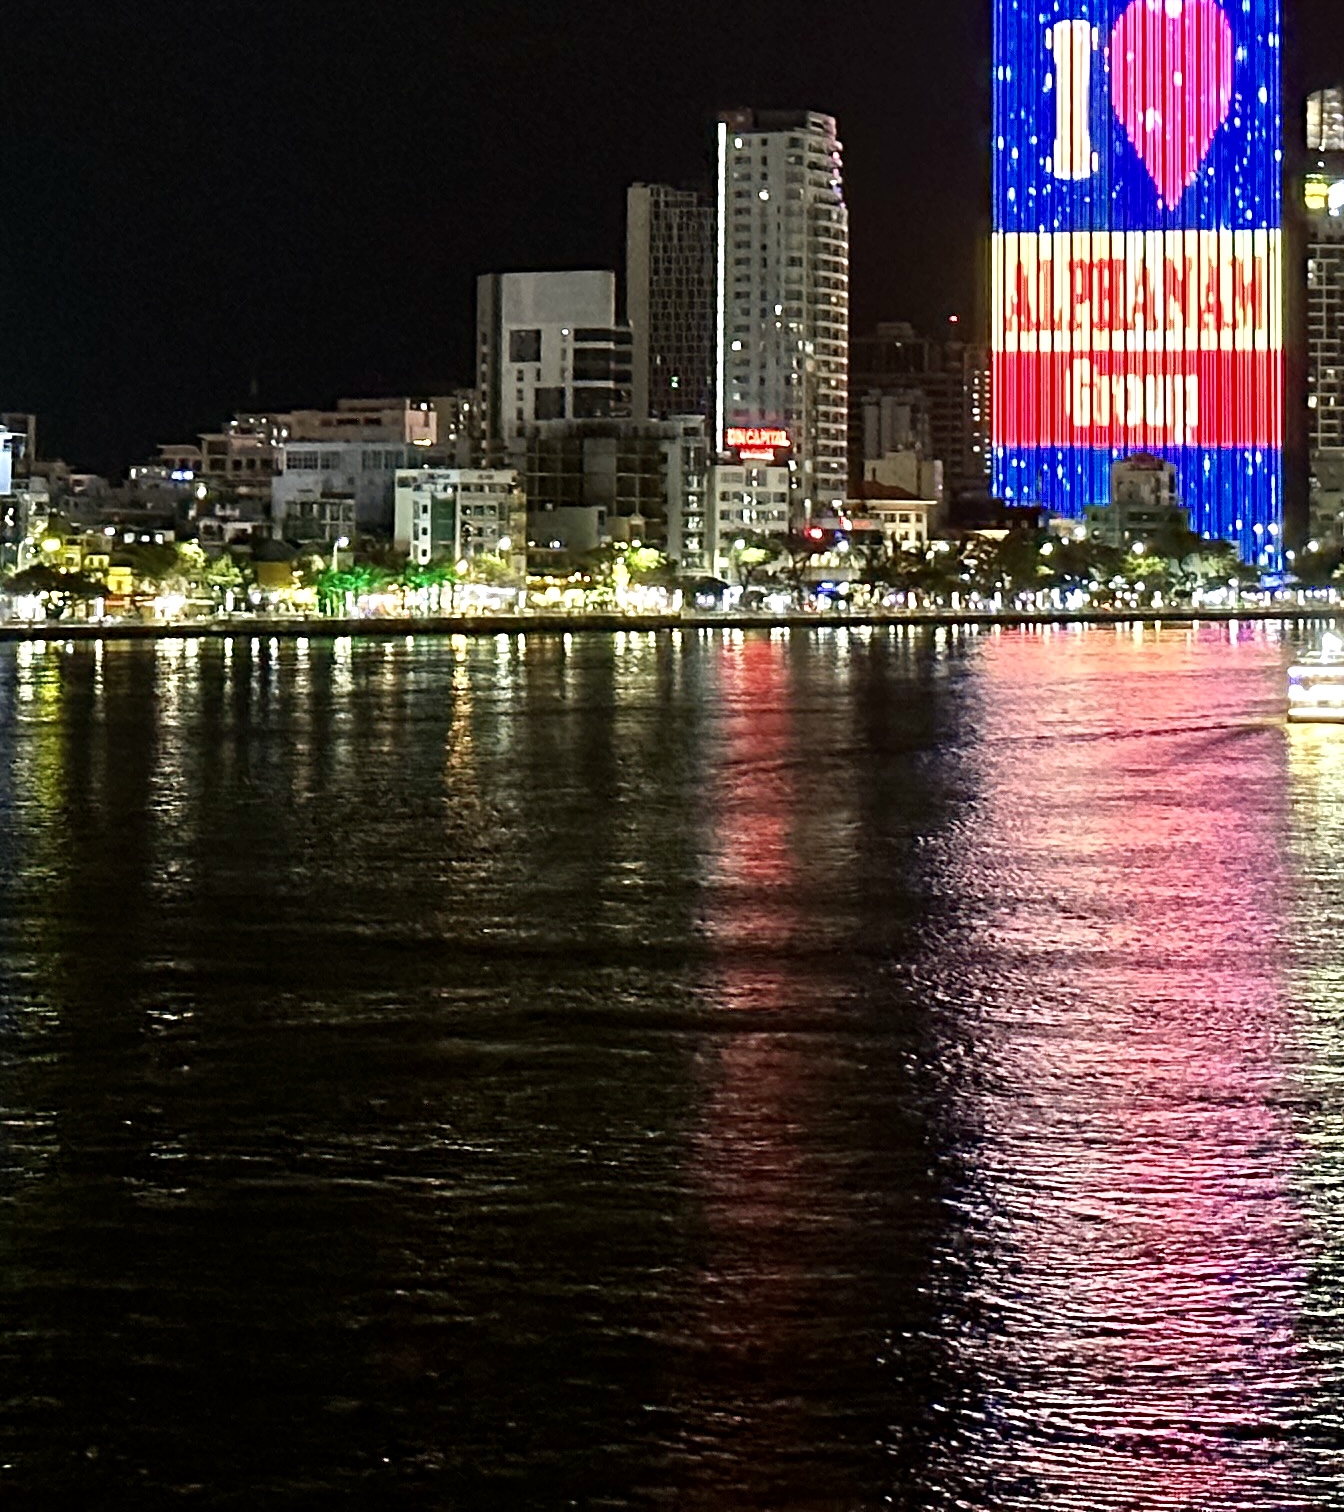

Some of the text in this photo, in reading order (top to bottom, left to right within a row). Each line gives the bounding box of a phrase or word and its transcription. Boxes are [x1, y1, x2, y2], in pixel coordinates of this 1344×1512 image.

[1046, 19, 1098, 180] I
[1005, 256, 1263, 332] ALPHANAM
[1065, 357, 1199, 445] Group
